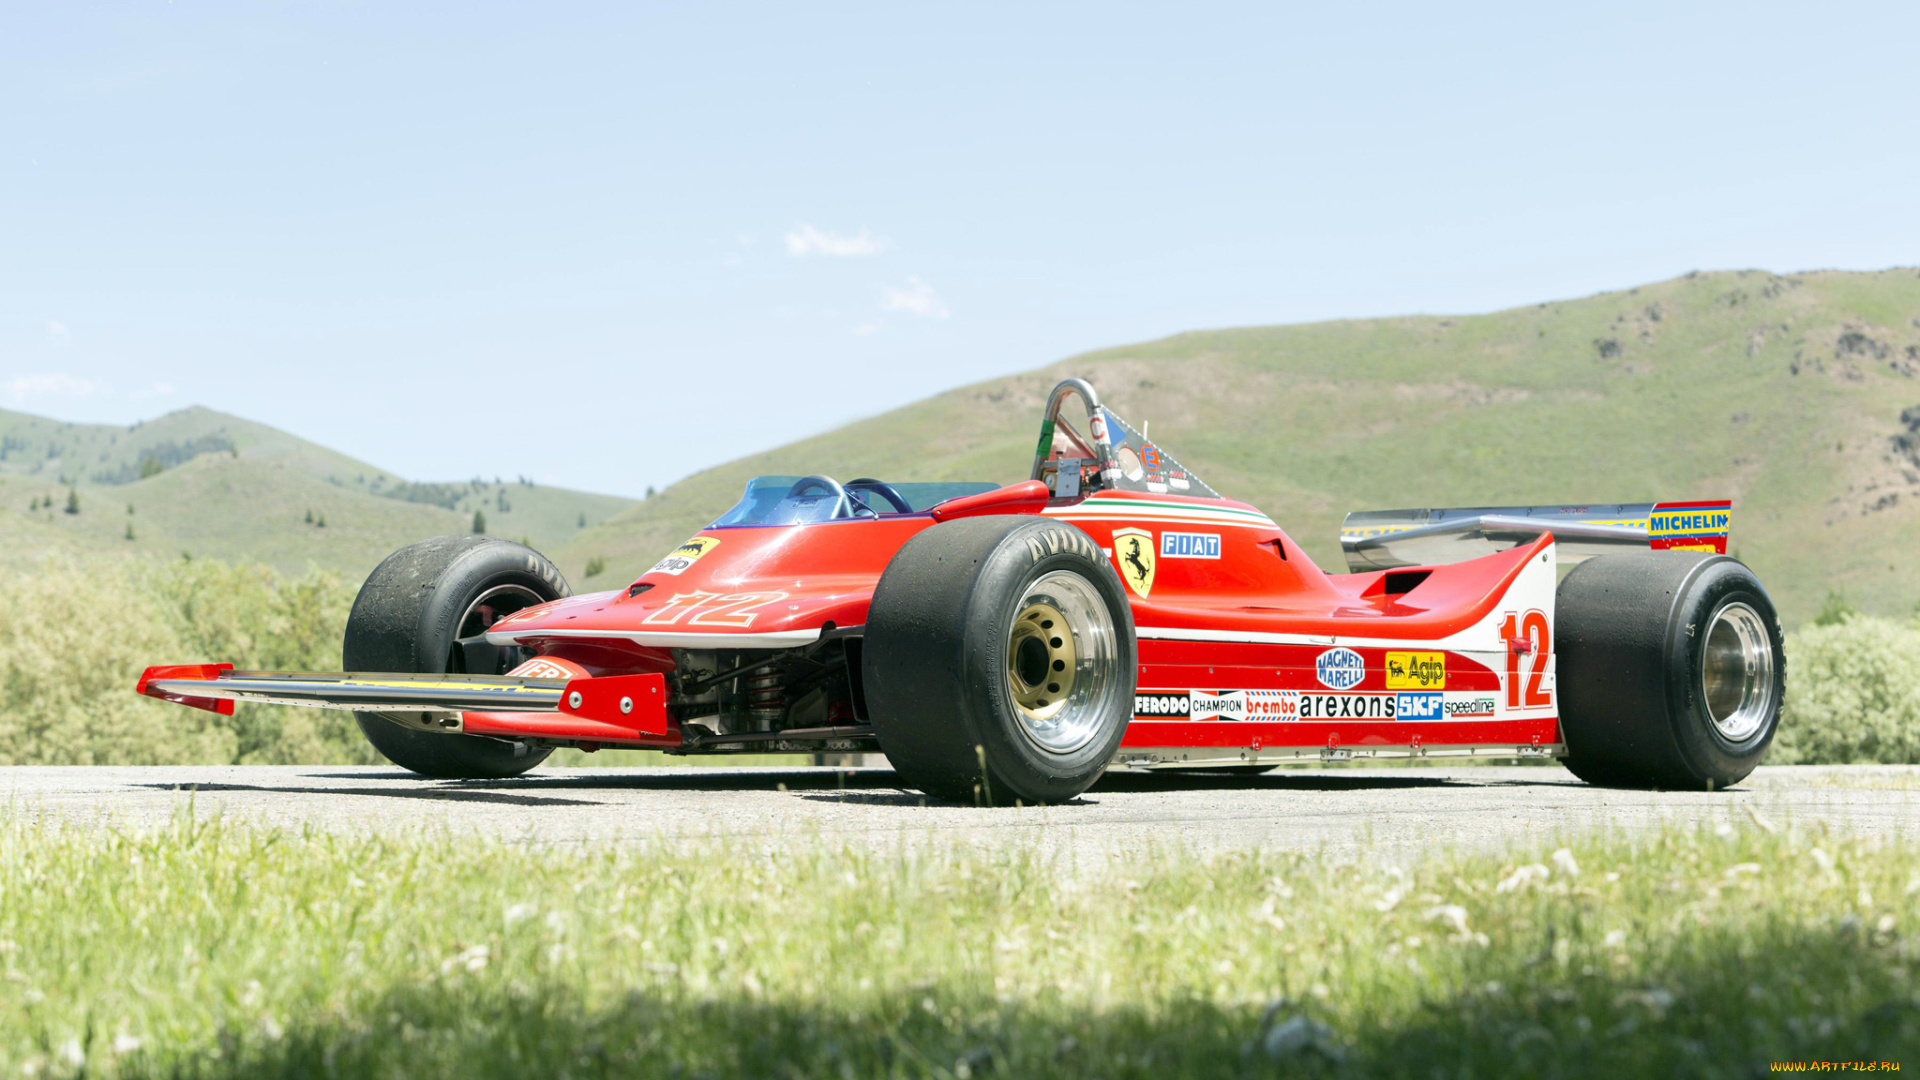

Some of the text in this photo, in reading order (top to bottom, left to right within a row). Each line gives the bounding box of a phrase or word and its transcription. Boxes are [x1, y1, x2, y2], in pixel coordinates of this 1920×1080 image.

[1143, 447, 1158, 469] E
[1650, 514, 1727, 531] MICHELIN
[1025, 528, 1097, 566] AVON
[1165, 536, 1218, 554] FIAT
[641, 590, 790, 628] 12
[1318, 650, 1362, 669] MAGNETI
[1497, 608, 1553, 711] 12
[1318, 667, 1363, 688] MARELLI
[1408, 656, 1443, 685] Agip
[1134, 696, 1190, 714] FERODO
[1193, 700, 1242, 712] CHAMPION
[1246, 697, 1296, 714] brembo
[1300, 695, 1395, 717] arexons
[1398, 696, 1442, 717] SKF
[1445, 698, 1494, 717] speedline
